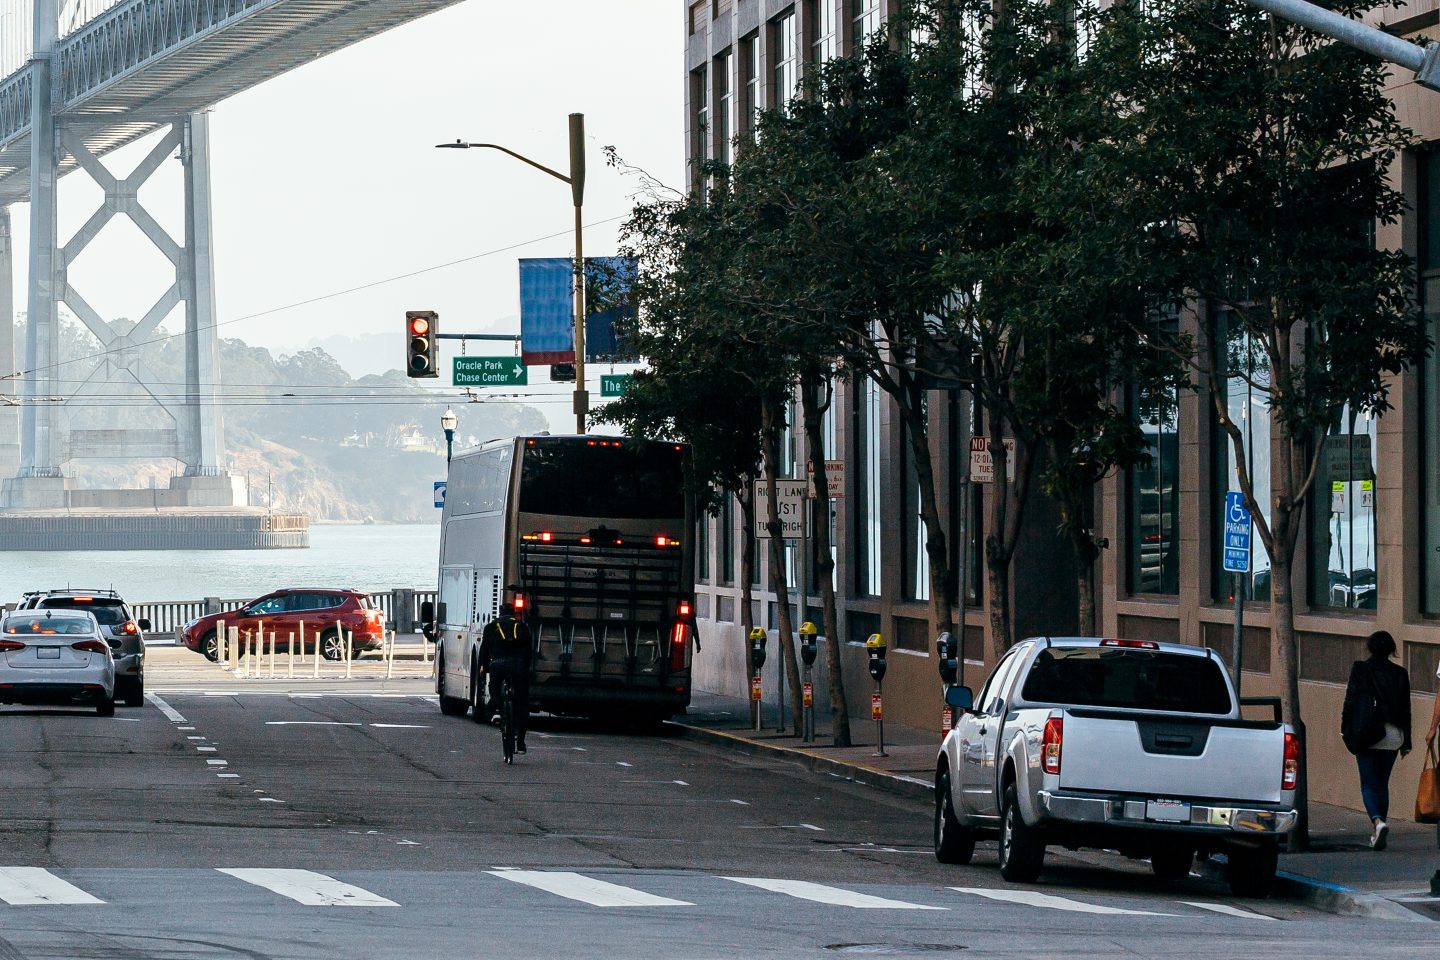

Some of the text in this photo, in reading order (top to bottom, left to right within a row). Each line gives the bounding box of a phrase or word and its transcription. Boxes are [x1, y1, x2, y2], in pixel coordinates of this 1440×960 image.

[456, 360, 503, 370] Oracle Park
[456, 372, 508, 382] Chase Center
[604, 380, 621, 392] The
[972, 438, 984, 450] NO
[1230, 535, 1245, 547] ONLY
